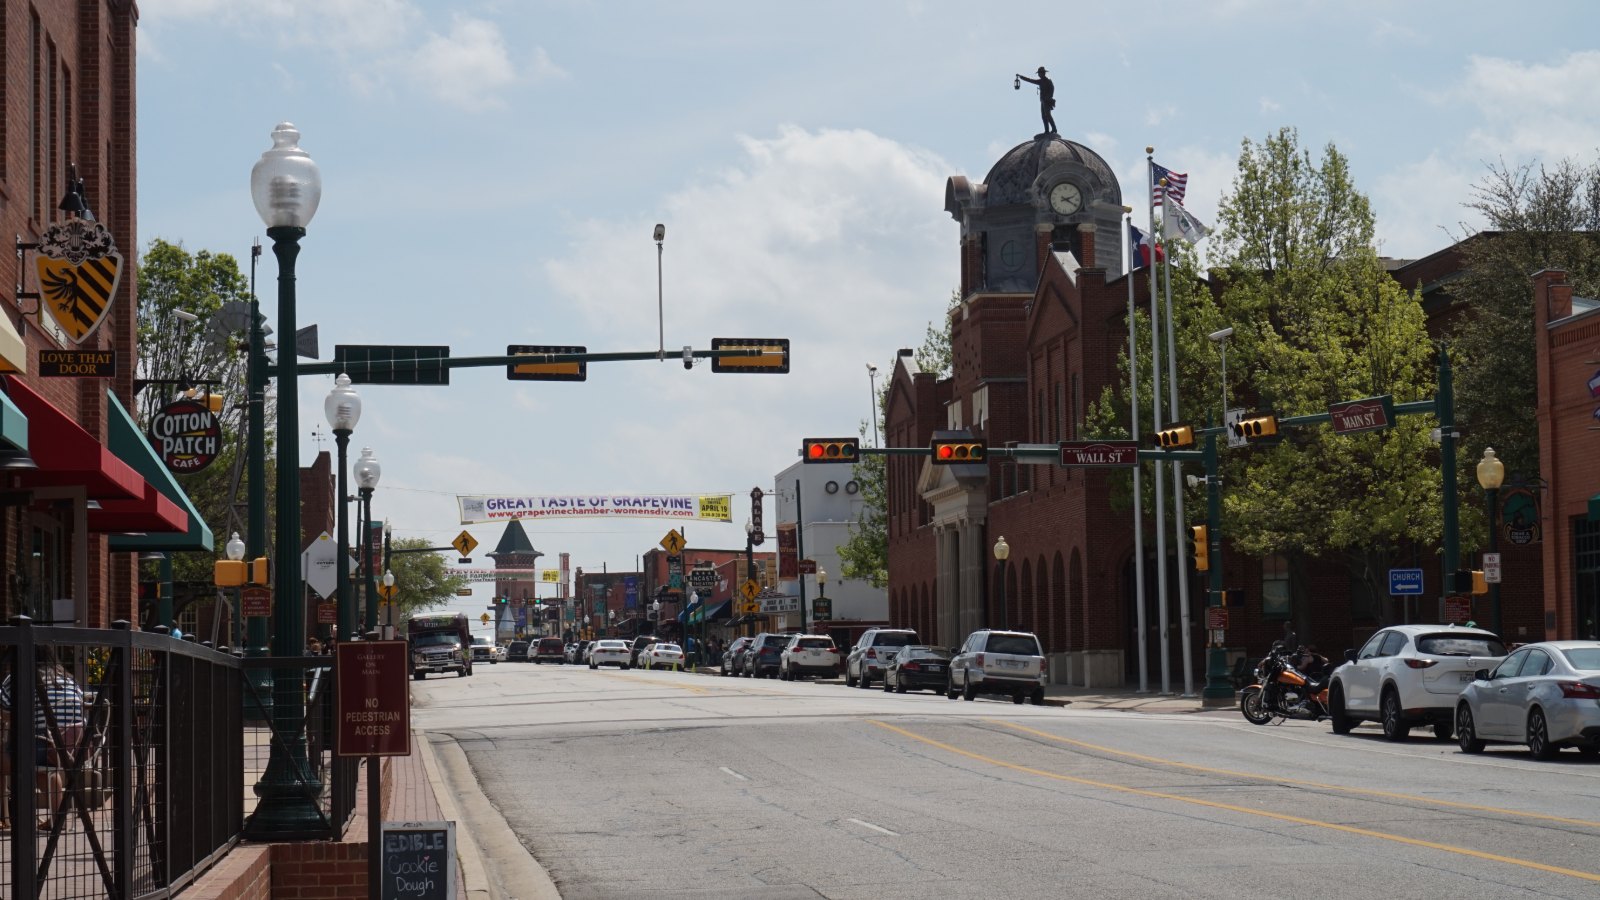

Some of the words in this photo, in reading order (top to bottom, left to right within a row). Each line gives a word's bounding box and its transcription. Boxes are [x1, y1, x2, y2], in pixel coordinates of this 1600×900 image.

[41, 353, 74, 363] LOVE
[79, 353, 112, 364] THAT
[59, 364, 97, 374] DOOR
[152, 412, 211, 440] COTTON
[1342, 415, 1365, 429] MAIN
[1364, 413, 1376, 426] ST
[163, 437, 216, 461] PATCH
[173, 457, 201, 468] CAFE
[1077, 452, 1106, 463] WALL
[1108, 452, 1123, 463] ST
[486, 498, 534, 510] GREAT
[541, 496, 586, 508] TASTE
[588, 496, 609, 507] OF
[612, 496, 693, 510] GRAPEVINE
[701, 504, 720, 512] APRIL
[720, 505, 728, 513] 19
[488, 507, 694, 518] www.grapevinechamber-womensdiv.com
[754, 491, 762, 540] PALACE
[1392, 572, 1420, 581] CHURCH
[365, 698, 379, 708] NO
[346, 711, 400, 722] PEDESTRIAN
[354, 725, 391, 736] ACCESS
[385, 832, 444, 853] EDIBLE
[387, 854, 439, 875] Cookie
[396, 876, 434, 897] Dough
